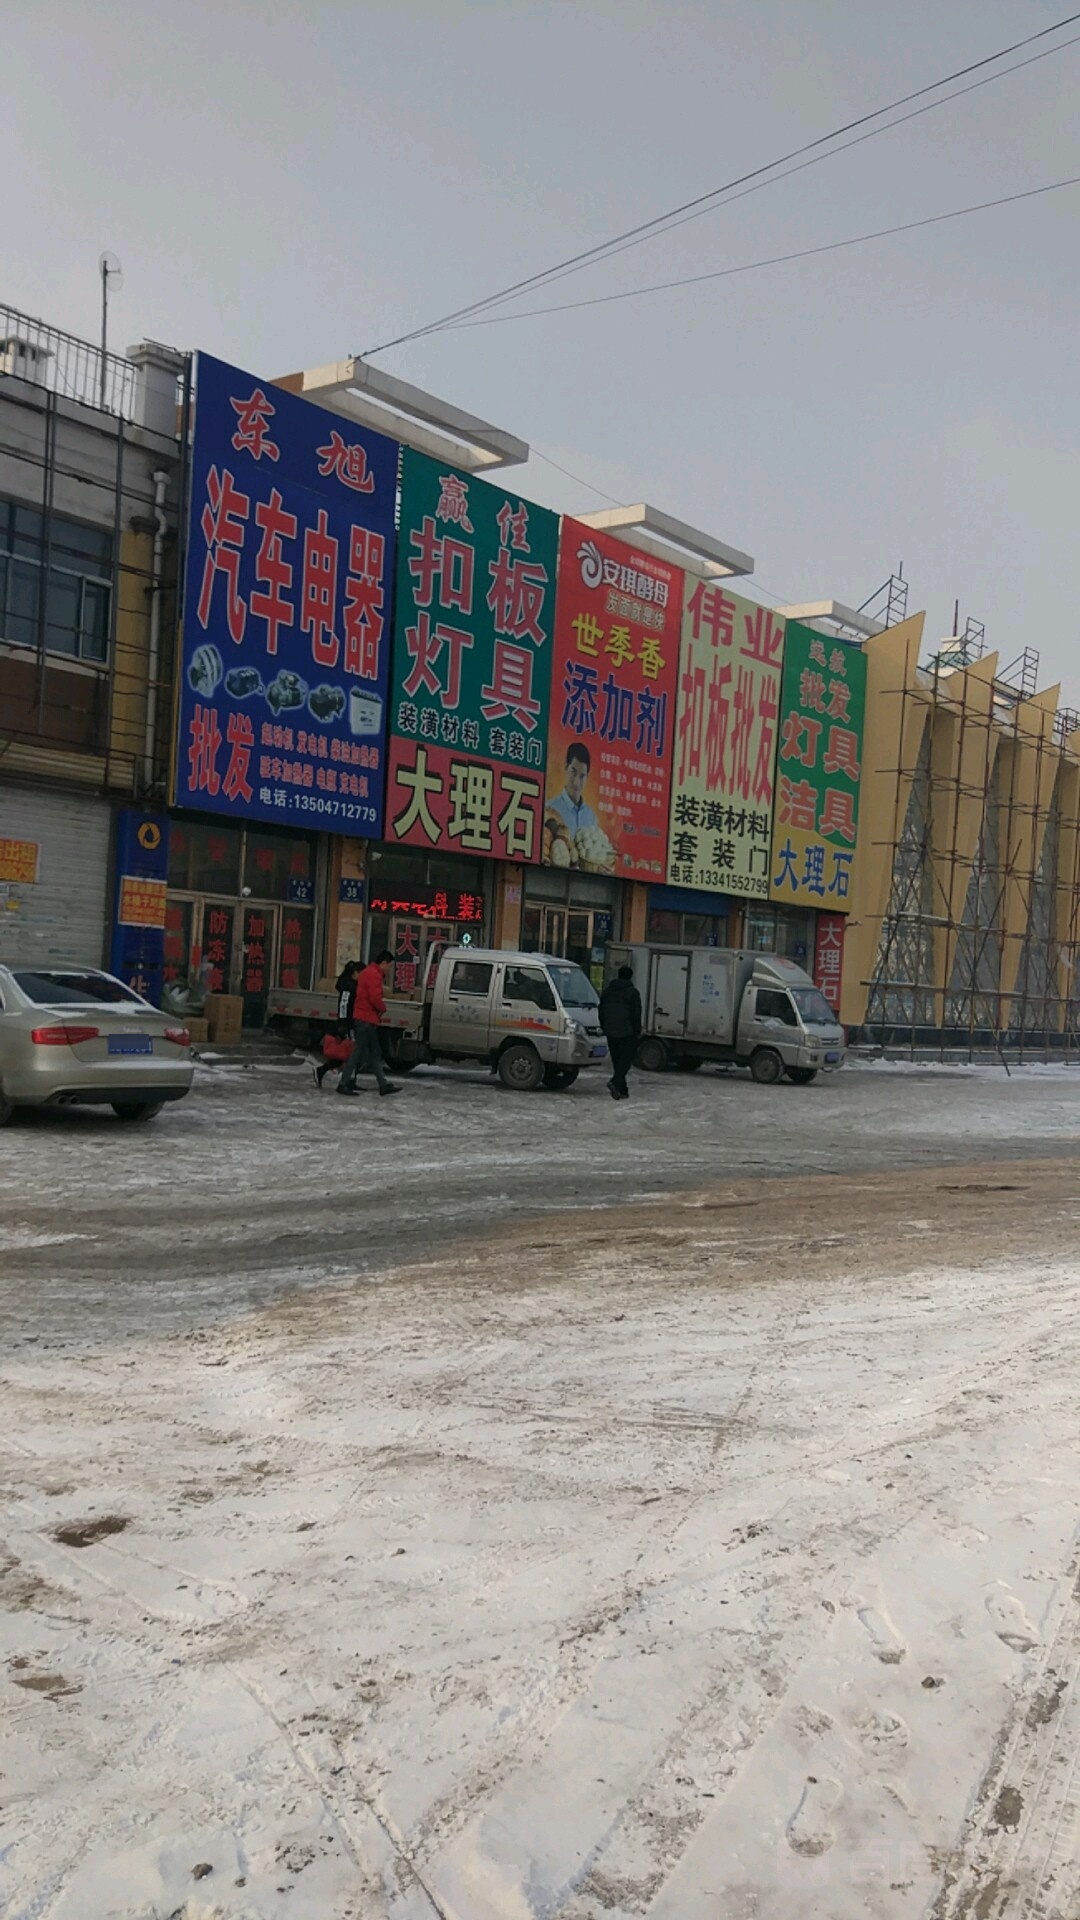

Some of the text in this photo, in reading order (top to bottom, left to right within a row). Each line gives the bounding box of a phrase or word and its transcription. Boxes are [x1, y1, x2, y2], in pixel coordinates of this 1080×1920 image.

[230, 387, 375, 492] 东旭
[436, 472, 531, 553] 赢佳
[197, 464, 386, 681] 汽车电器
[408, 516, 549, 647] 扣板
[602, 557, 670, 610] 安琪酵母
[571, 612, 666, 681] 世季香
[687, 580, 784, 669] 伟业
[401, 608, 541, 732] 灯具
[561, 659, 668, 758] 添加剂
[799, 667, 852, 724] 批发
[188, 703, 255, 804] 批发
[397, 701, 543, 765] 装潢材料 套装门
[678, 643, 779, 807] 扣板批发
[780, 711, 861, 783] 灯具
[259, 786, 377, 822] 电话:13504712779
[394, 744, 542, 859] 大理石
[674, 794, 770, 844] 装潢材料
[778, 777, 858, 845] 洁具
[669, 862, 769, 896] 电话:13341552799
[672, 831, 769, 877] 套装门
[774, 838, 855, 900] 大理石
[245, 914, 265, 992] 加热器
[817, 922, 842, 1001] 大理石
